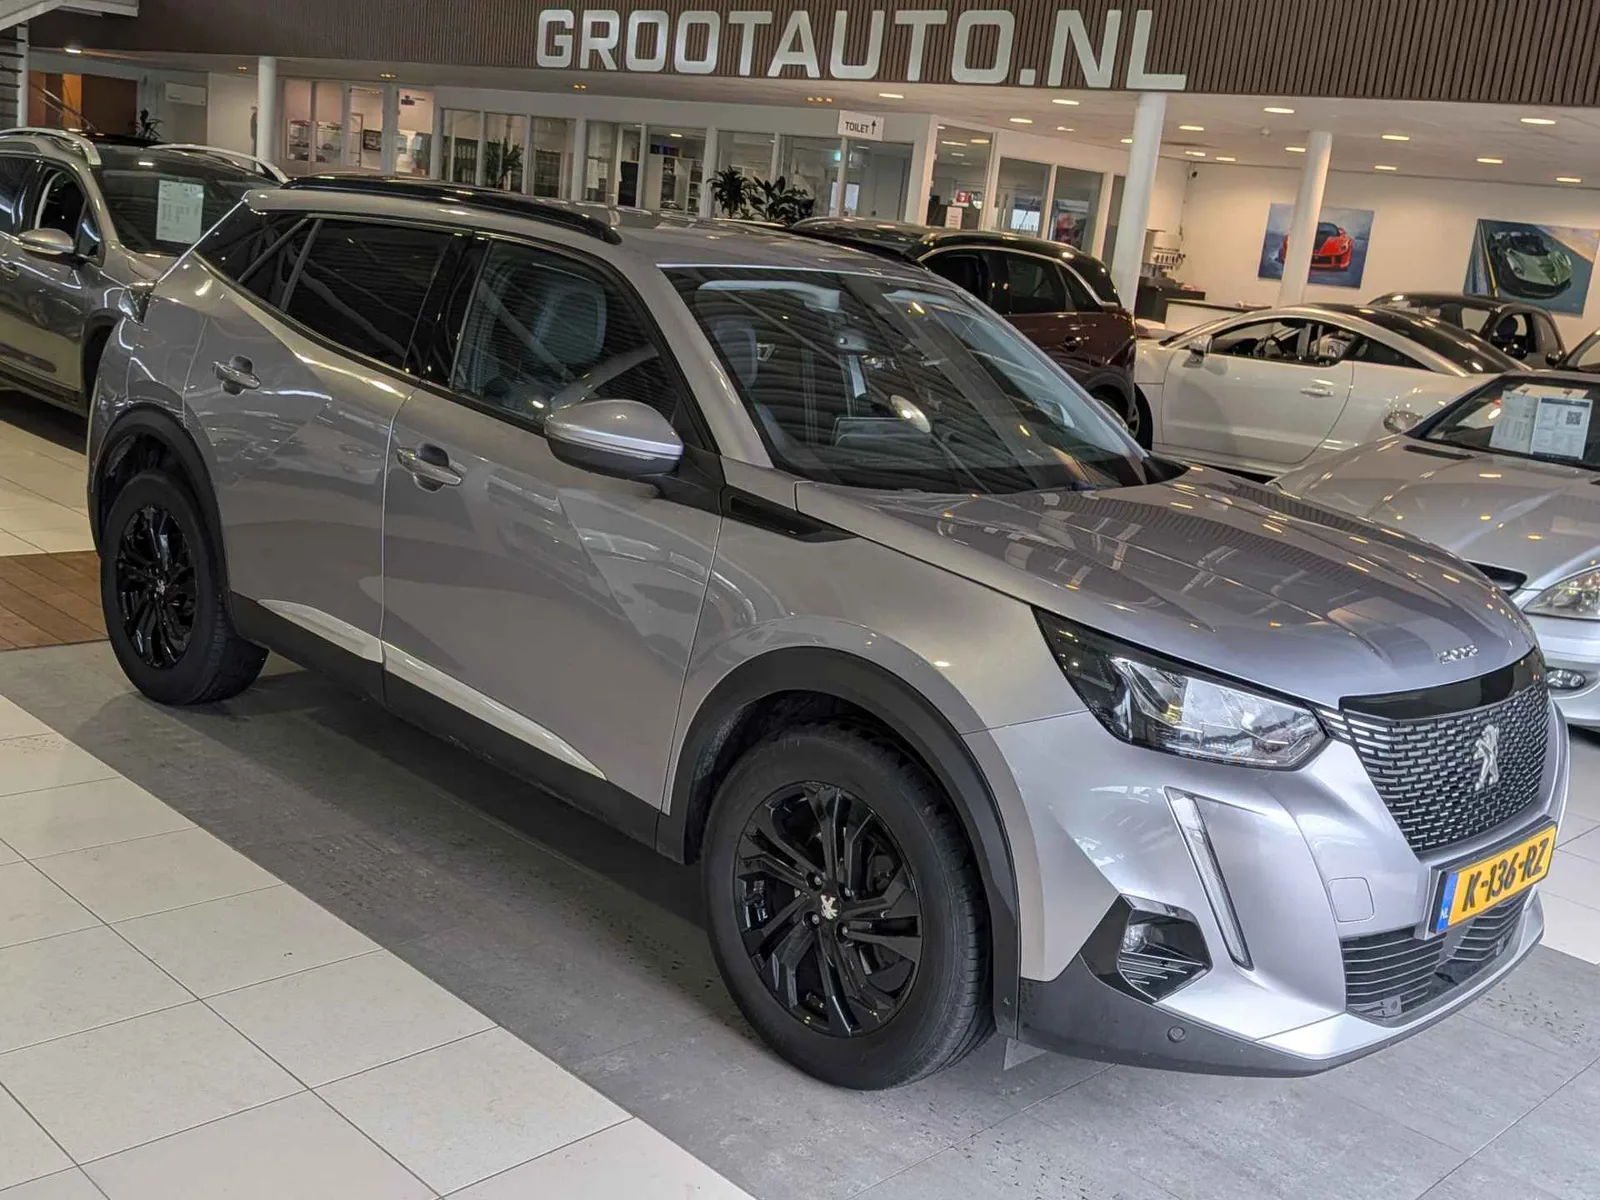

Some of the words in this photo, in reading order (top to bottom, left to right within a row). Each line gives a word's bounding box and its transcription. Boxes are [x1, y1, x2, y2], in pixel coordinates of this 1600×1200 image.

[536, 9, 1187, 91] GROOTAUTO.NL
[845, 121, 869, 133] TOILET
[1462, 837, 1550, 912] K-136-RZ
[1440, 907, 1449, 920] NL
